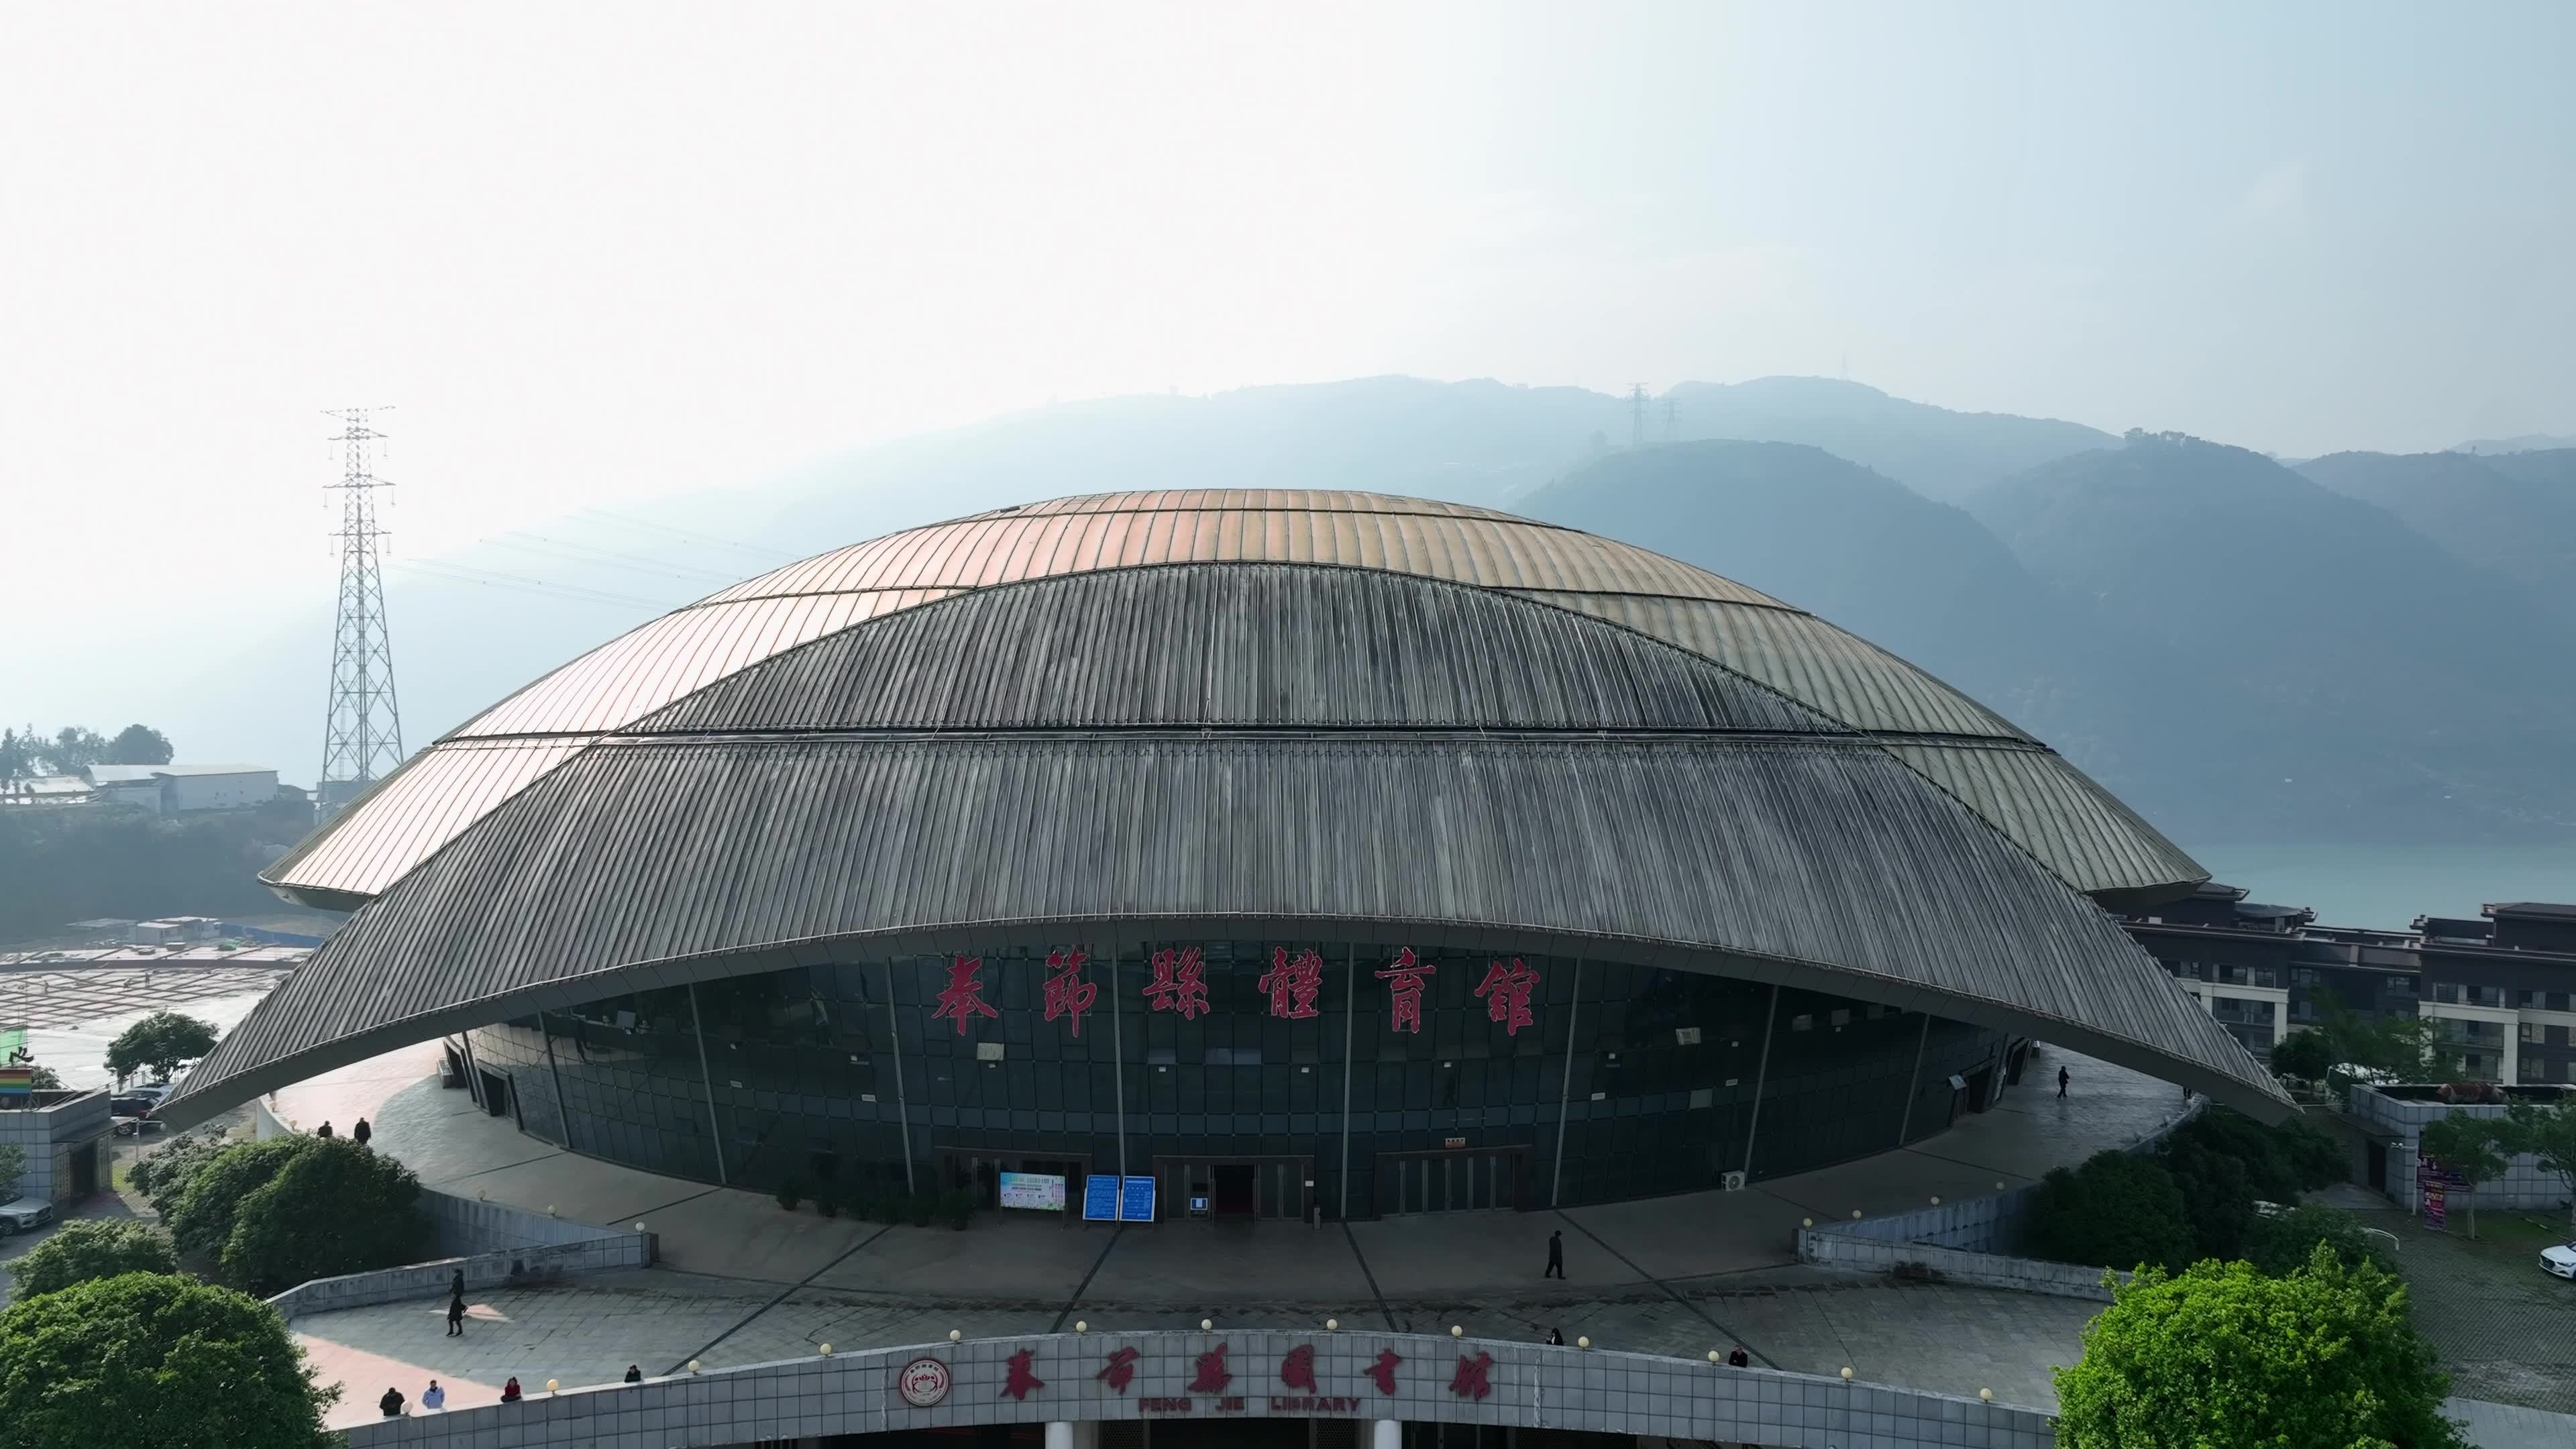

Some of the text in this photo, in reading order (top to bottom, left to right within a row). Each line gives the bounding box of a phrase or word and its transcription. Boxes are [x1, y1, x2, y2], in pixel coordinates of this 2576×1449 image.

[1138, 1397, 1362, 1412] FENG JIE LIBRARY
